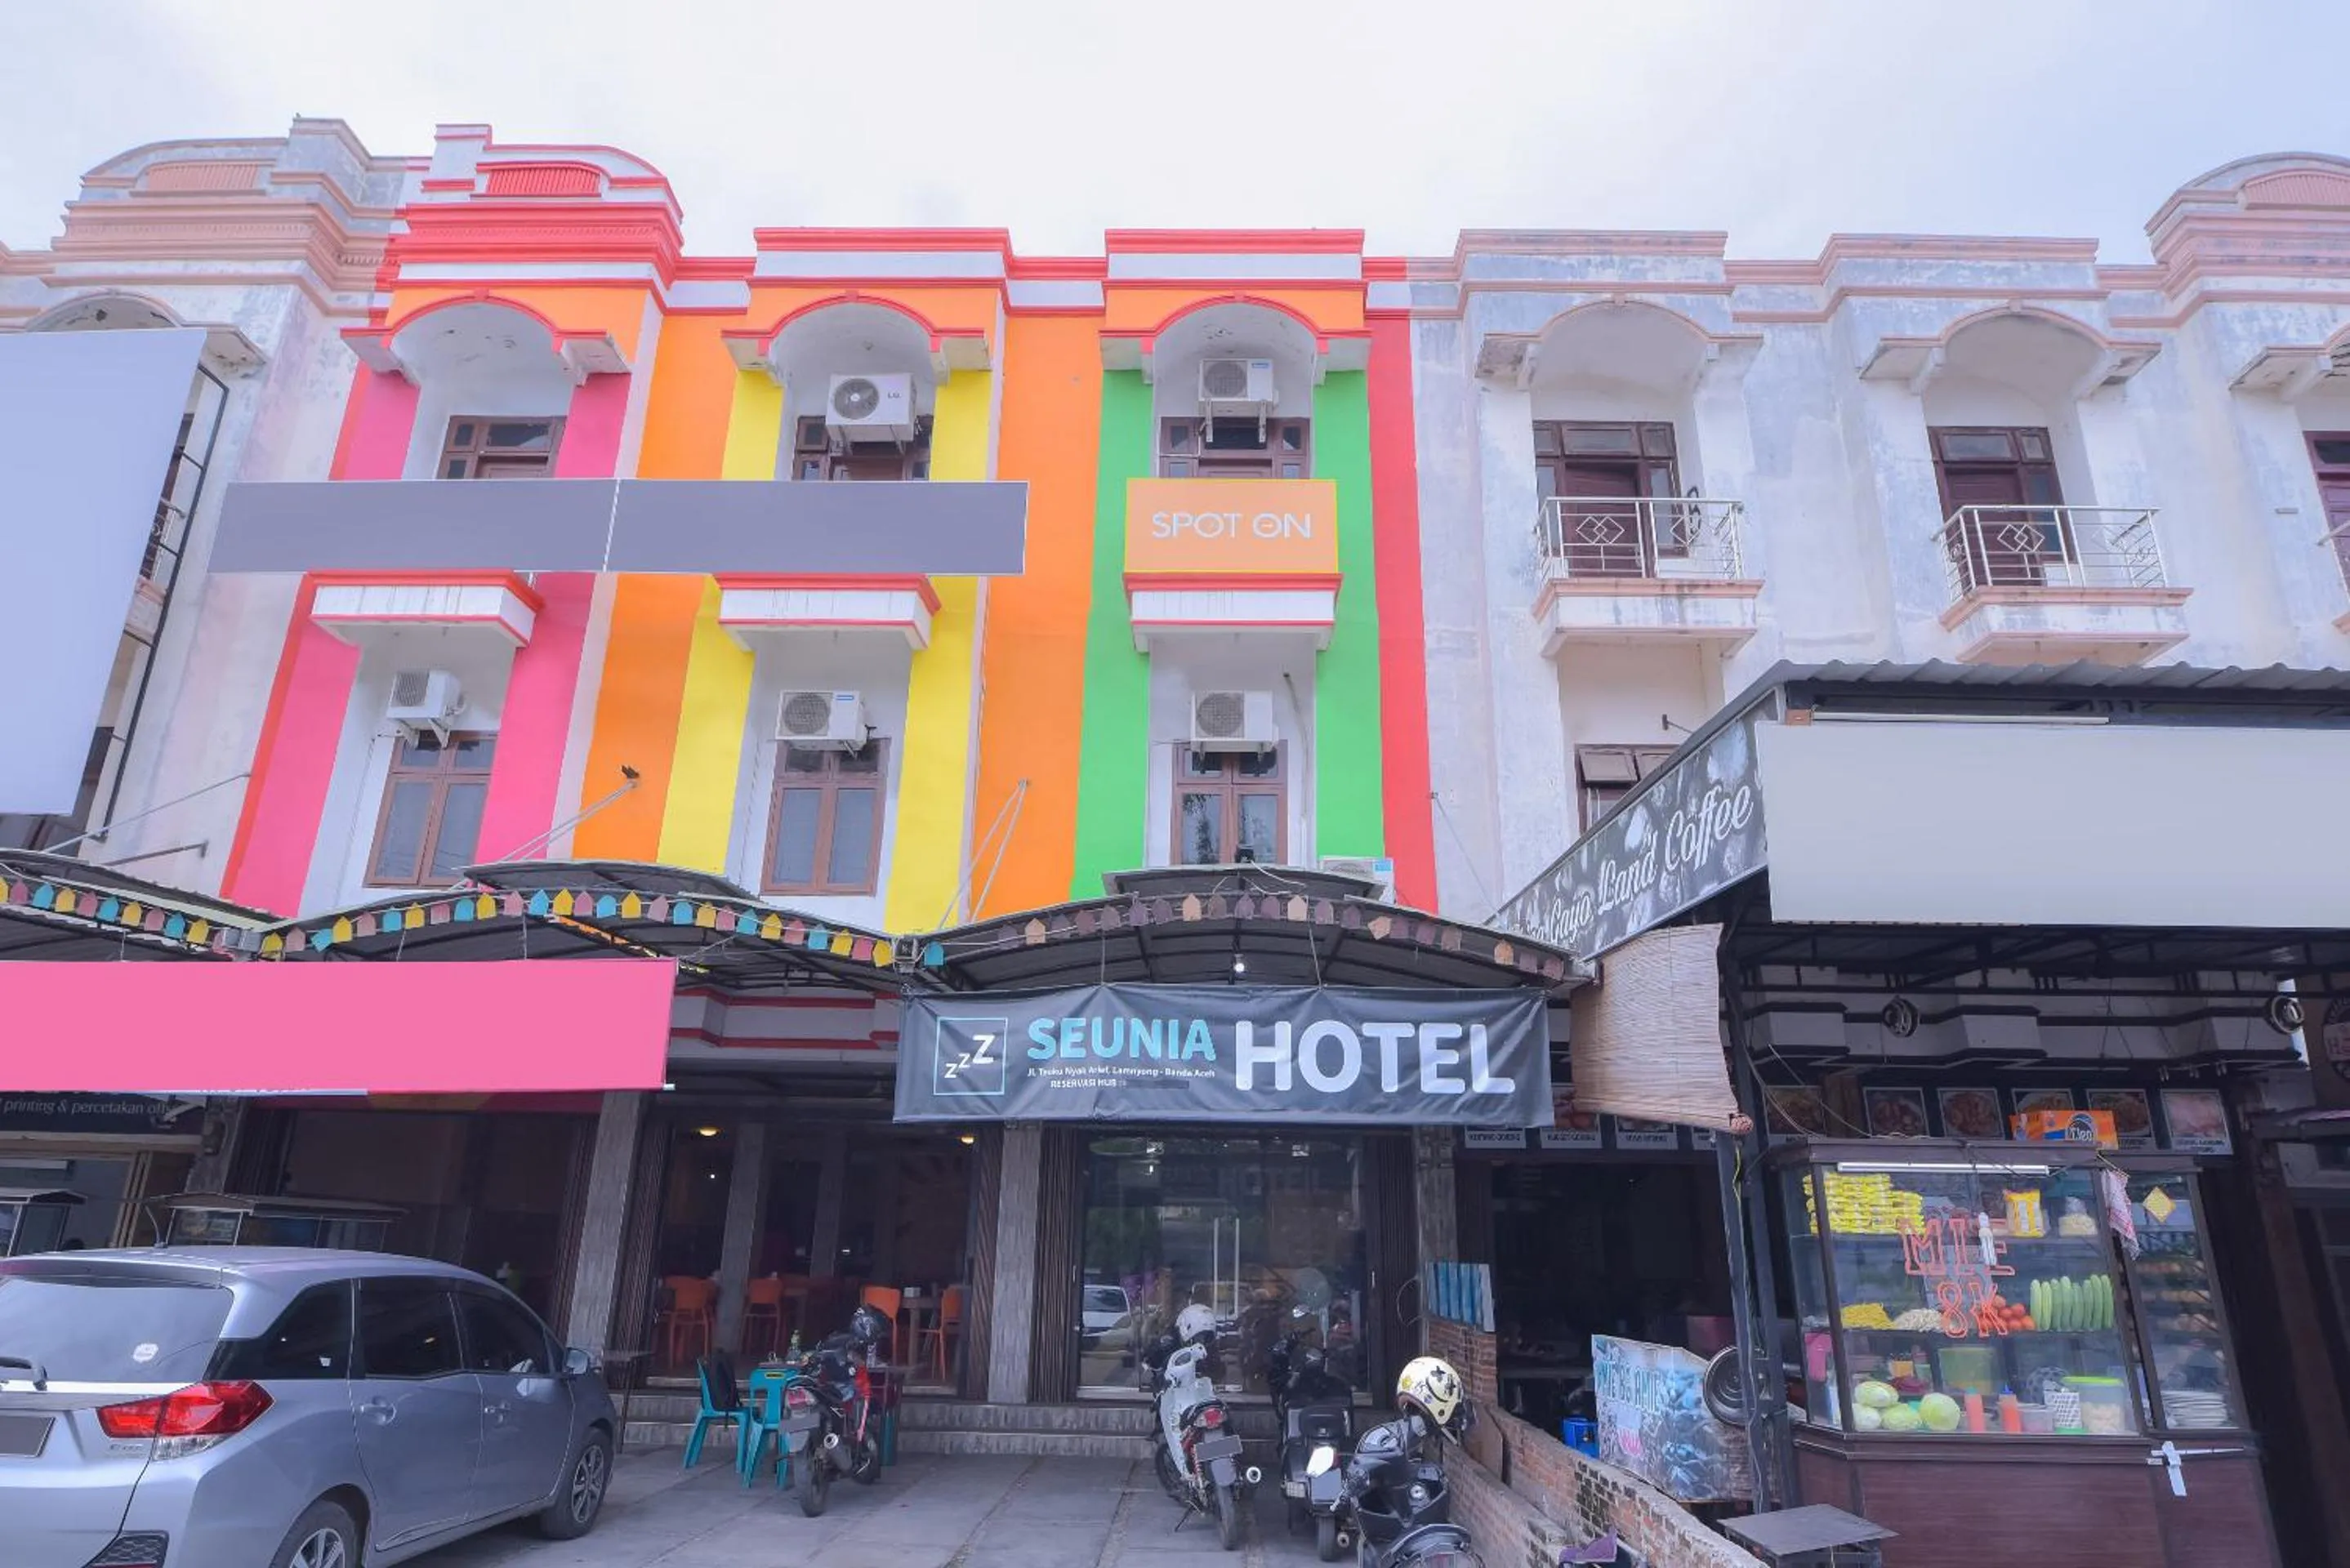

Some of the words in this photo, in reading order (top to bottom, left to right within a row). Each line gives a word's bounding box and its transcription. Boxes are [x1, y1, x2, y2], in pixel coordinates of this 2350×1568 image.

[1152, 511, 1243, 539] SPOT
[1252, 512, 1312, 539] ON
[1598, 831, 1659, 915] Land
[1665, 784, 1755, 871] Coffee
[1027, 1018, 1216, 1061] SEUNIA
[1235, 1020, 1516, 1094] HOTEL
[1050, 1078, 1096, 1089] RESERVASI
[1165, 1067, 1193, 1077] Banda
[1193, 1068, 1216, 1079] Aceh
[2, 1098, 56, 1116] printing
[57, 1098, 68, 1114] &
[71, 1100, 145, 1116] percetakan
